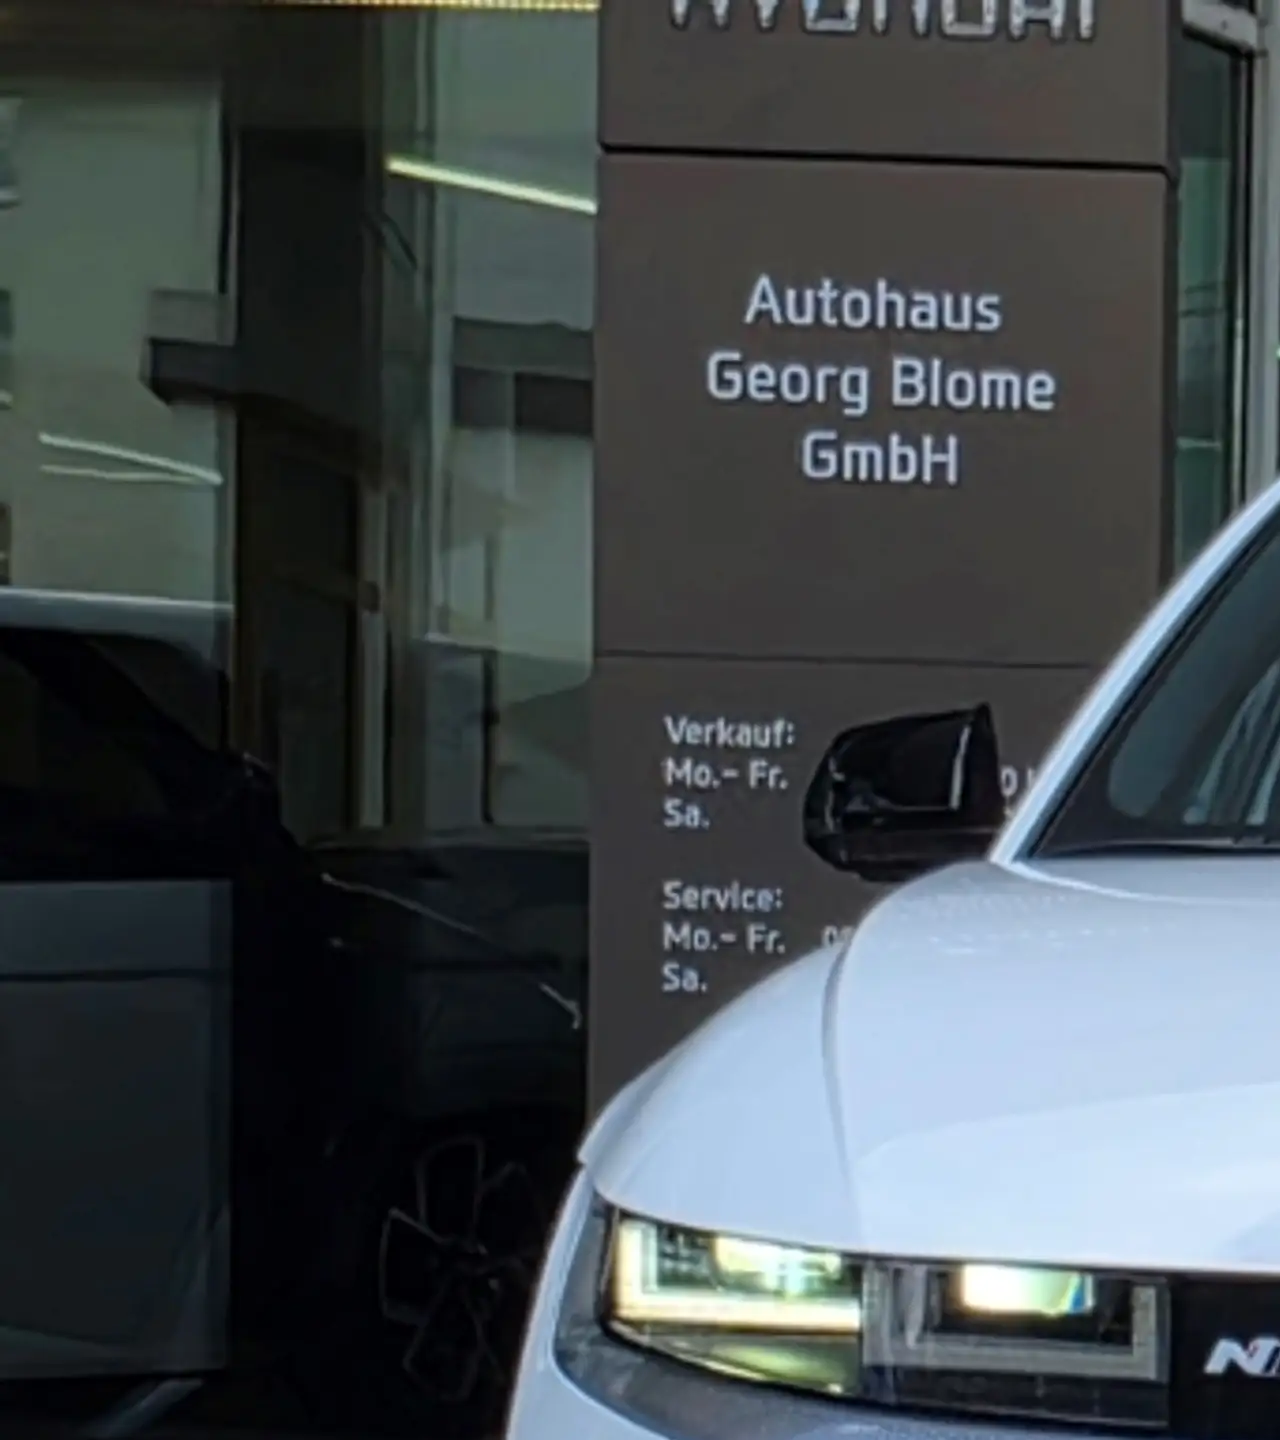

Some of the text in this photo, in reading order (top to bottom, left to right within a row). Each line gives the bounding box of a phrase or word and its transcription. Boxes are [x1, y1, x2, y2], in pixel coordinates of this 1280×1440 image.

[744, 273, 1001, 331] Autohaus
[707, 350, 1057, 416] Georg Blome
[802, 430, 958, 484] GmbH
[663, 715, 795, 748] Verkauf:
[748, 758, 789, 791] Fr.
[663, 797, 710, 829] Sa.
[662, 880, 783, 912] Service:
[747, 923, 787, 954] Fr.
[661, 961, 708, 992] Sa.
[1203, 1338, 1280, 1376] N
